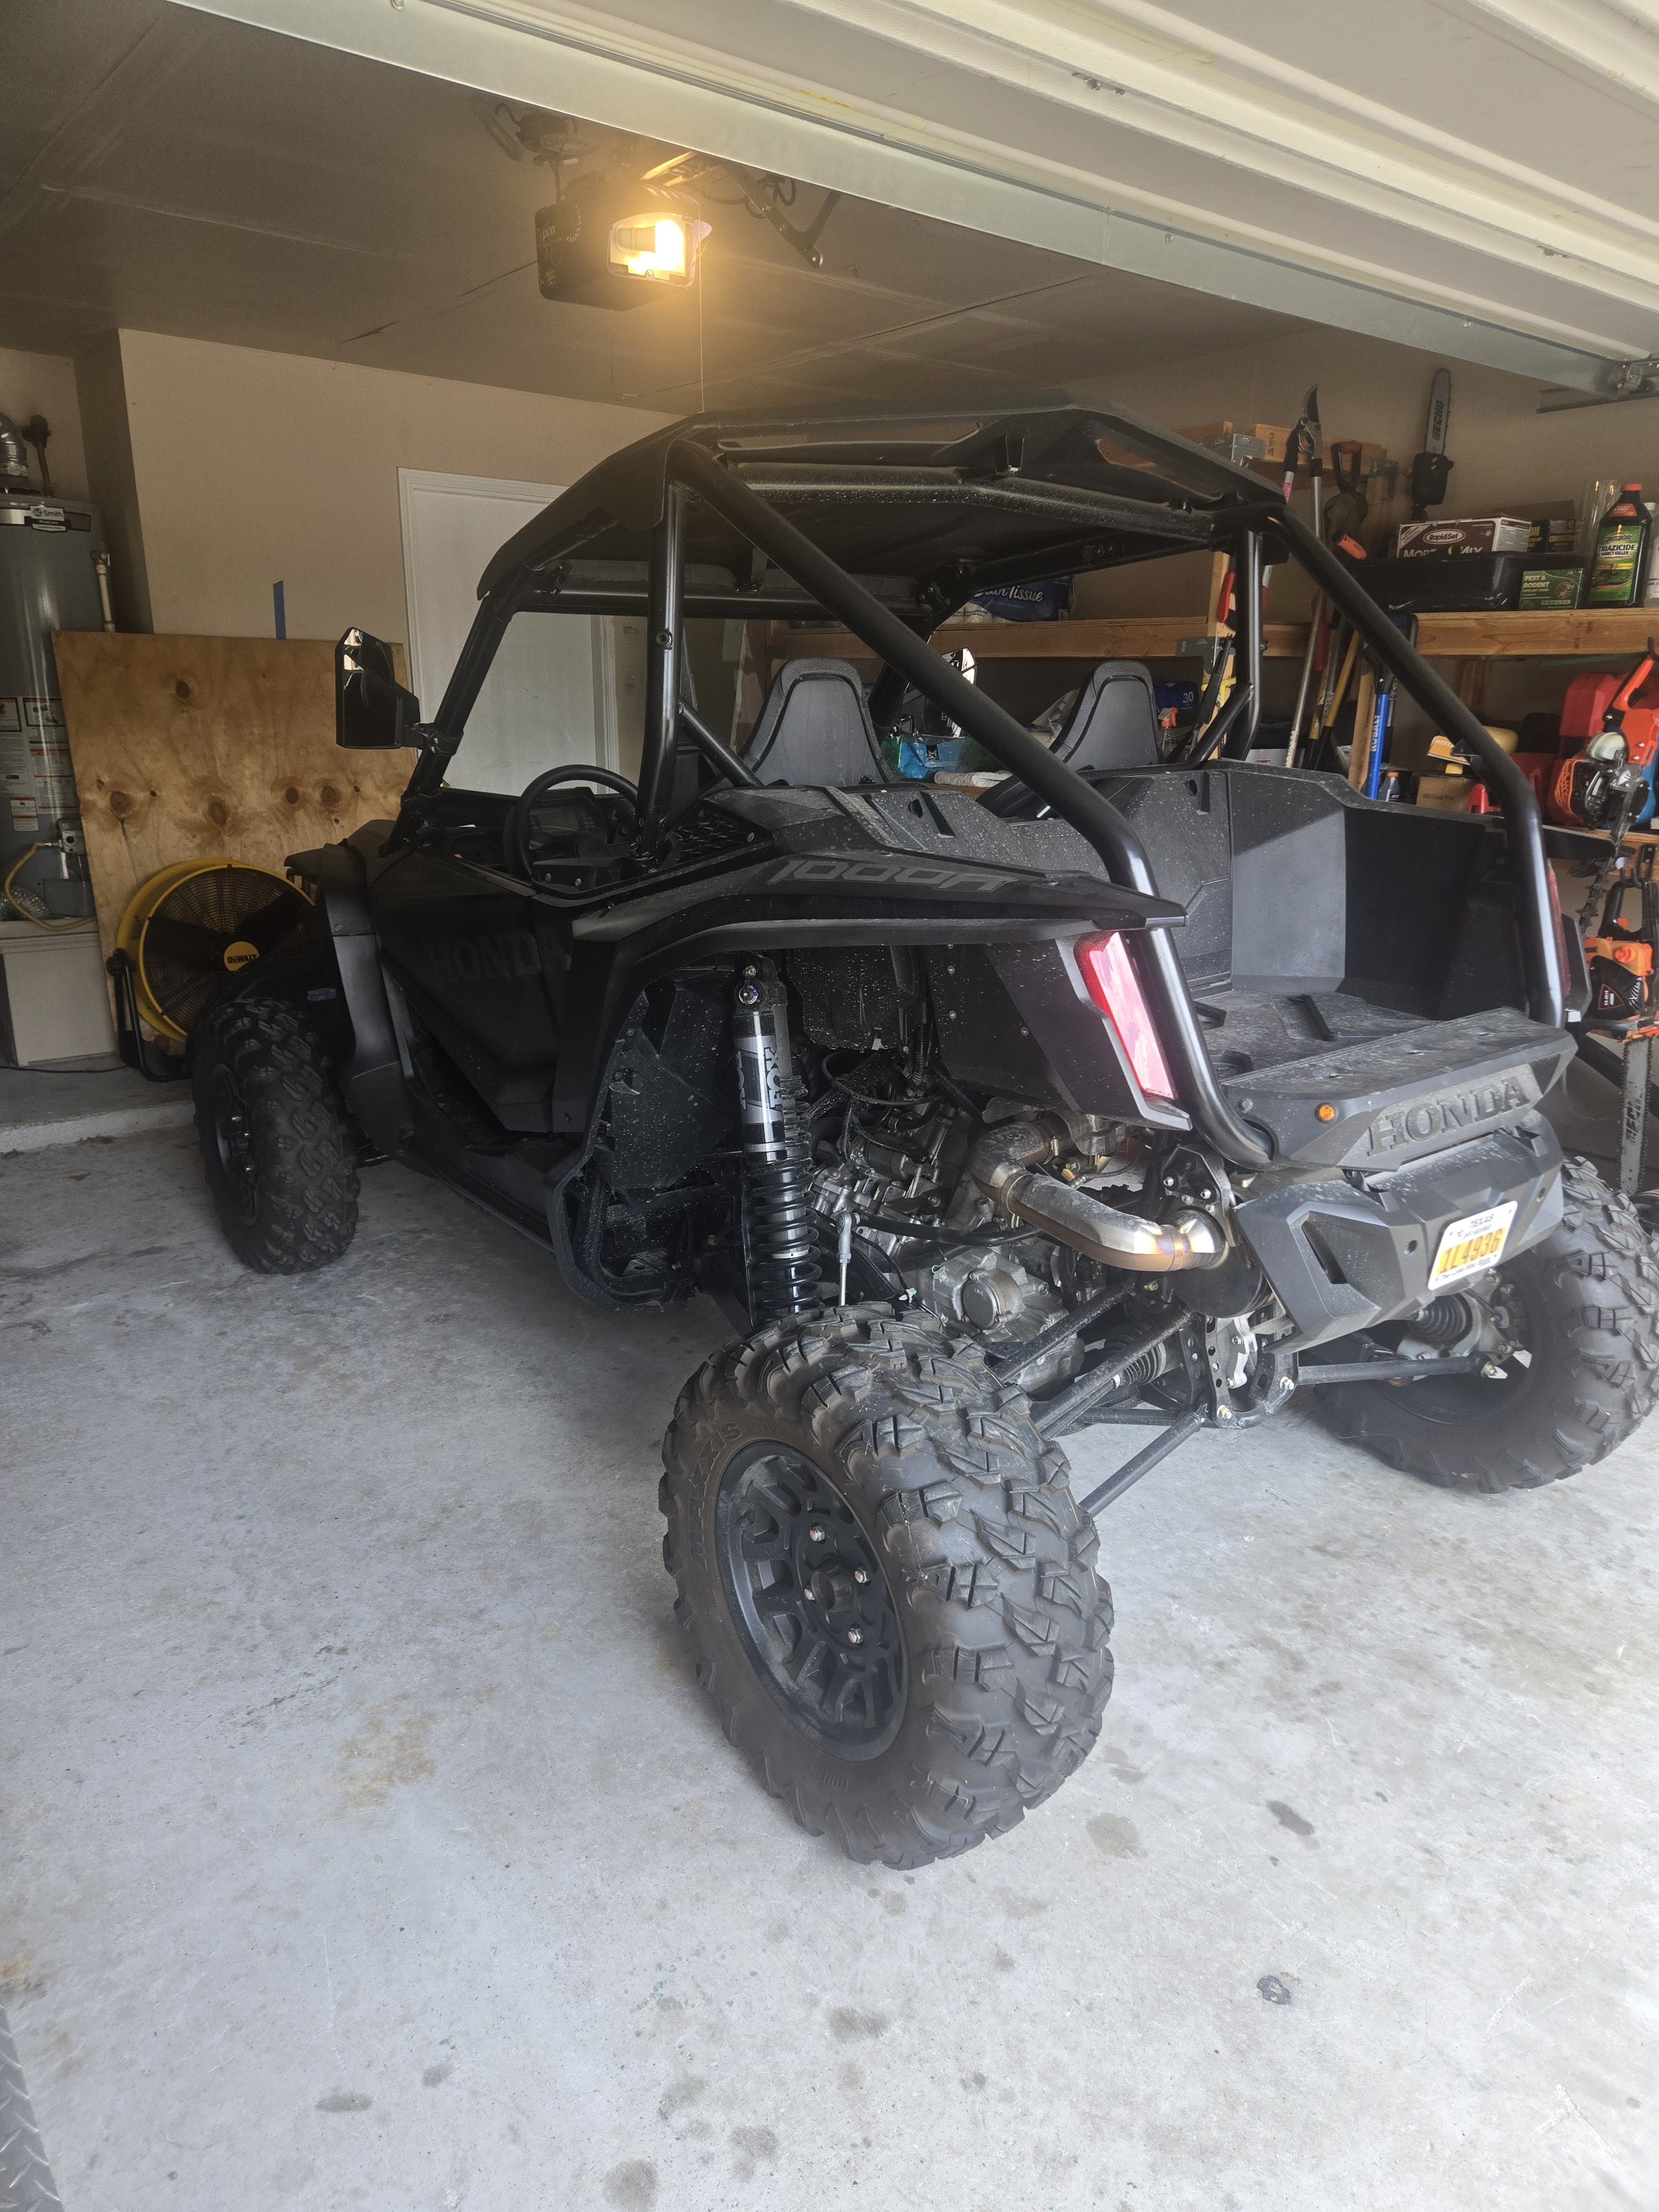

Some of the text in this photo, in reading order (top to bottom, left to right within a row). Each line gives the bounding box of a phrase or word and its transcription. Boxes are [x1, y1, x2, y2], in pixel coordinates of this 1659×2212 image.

[1433, 399, 1444, 439] ECHO
[1009, 585, 1044, 602] Tissue
[1182, 691, 1194, 703] 30
[766, 859, 1018, 893] 1000R
[427, 927, 572, 982] HONDA
[1366, 1076, 1530, 1156] HONDA
[688, 1423, 742, 1569] MAXXIS
